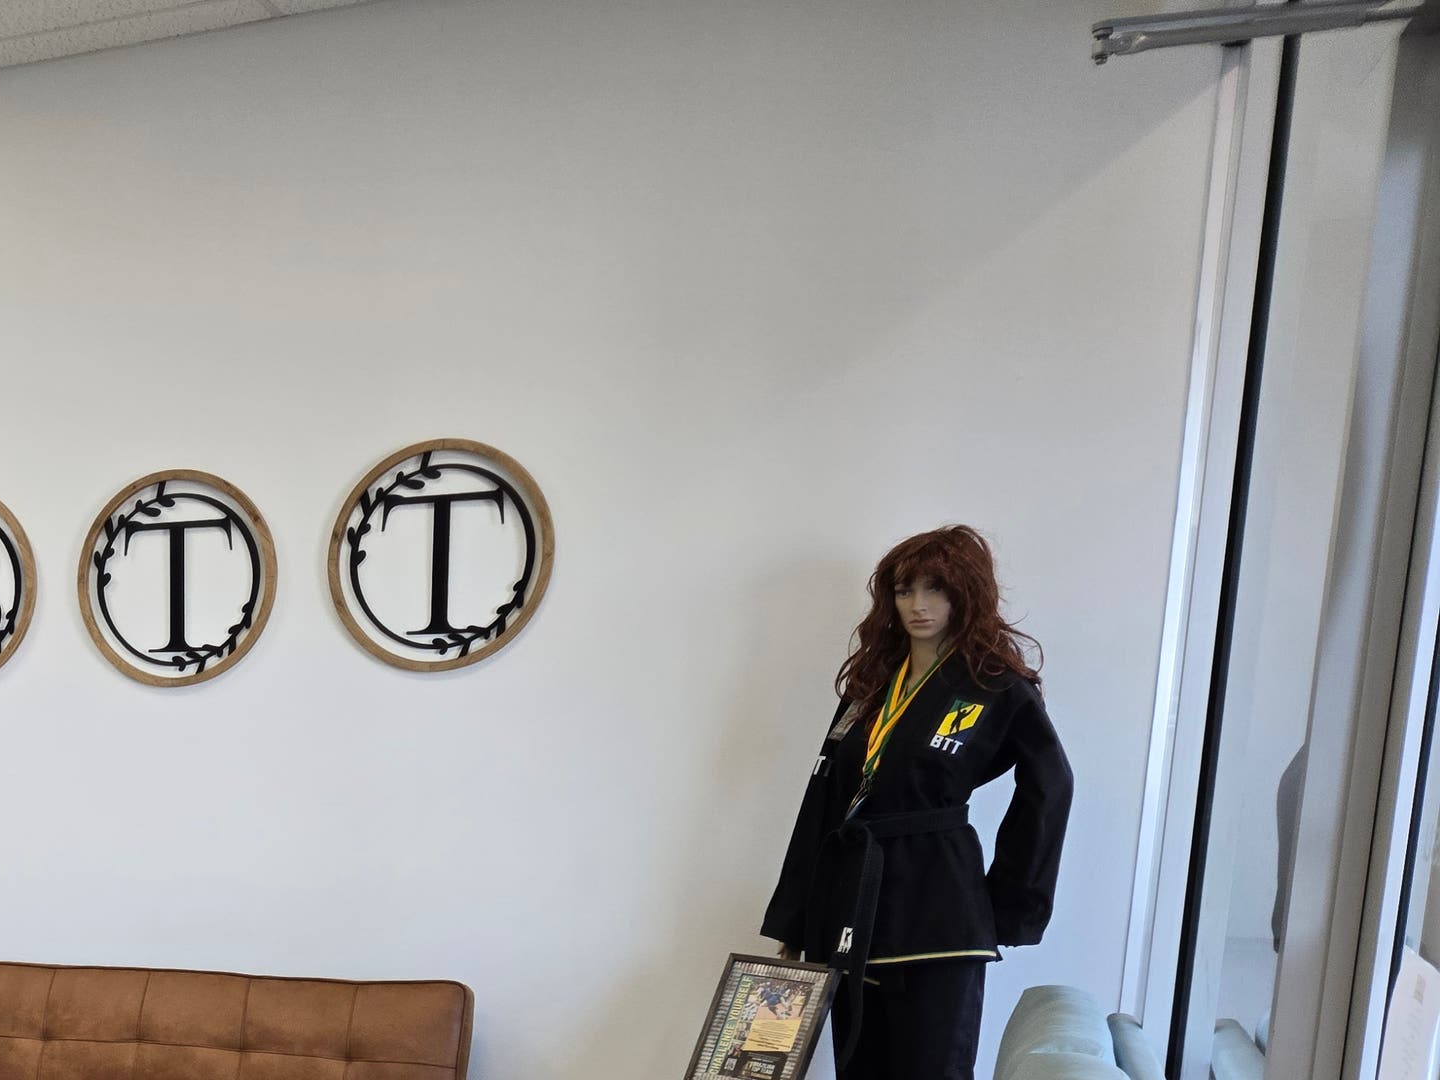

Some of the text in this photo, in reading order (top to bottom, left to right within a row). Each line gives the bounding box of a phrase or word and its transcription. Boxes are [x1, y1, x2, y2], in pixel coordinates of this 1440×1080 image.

[930, 735, 963, 754] BTT
[710, 976, 752, 1073] CHALLENGE YOURSELF
